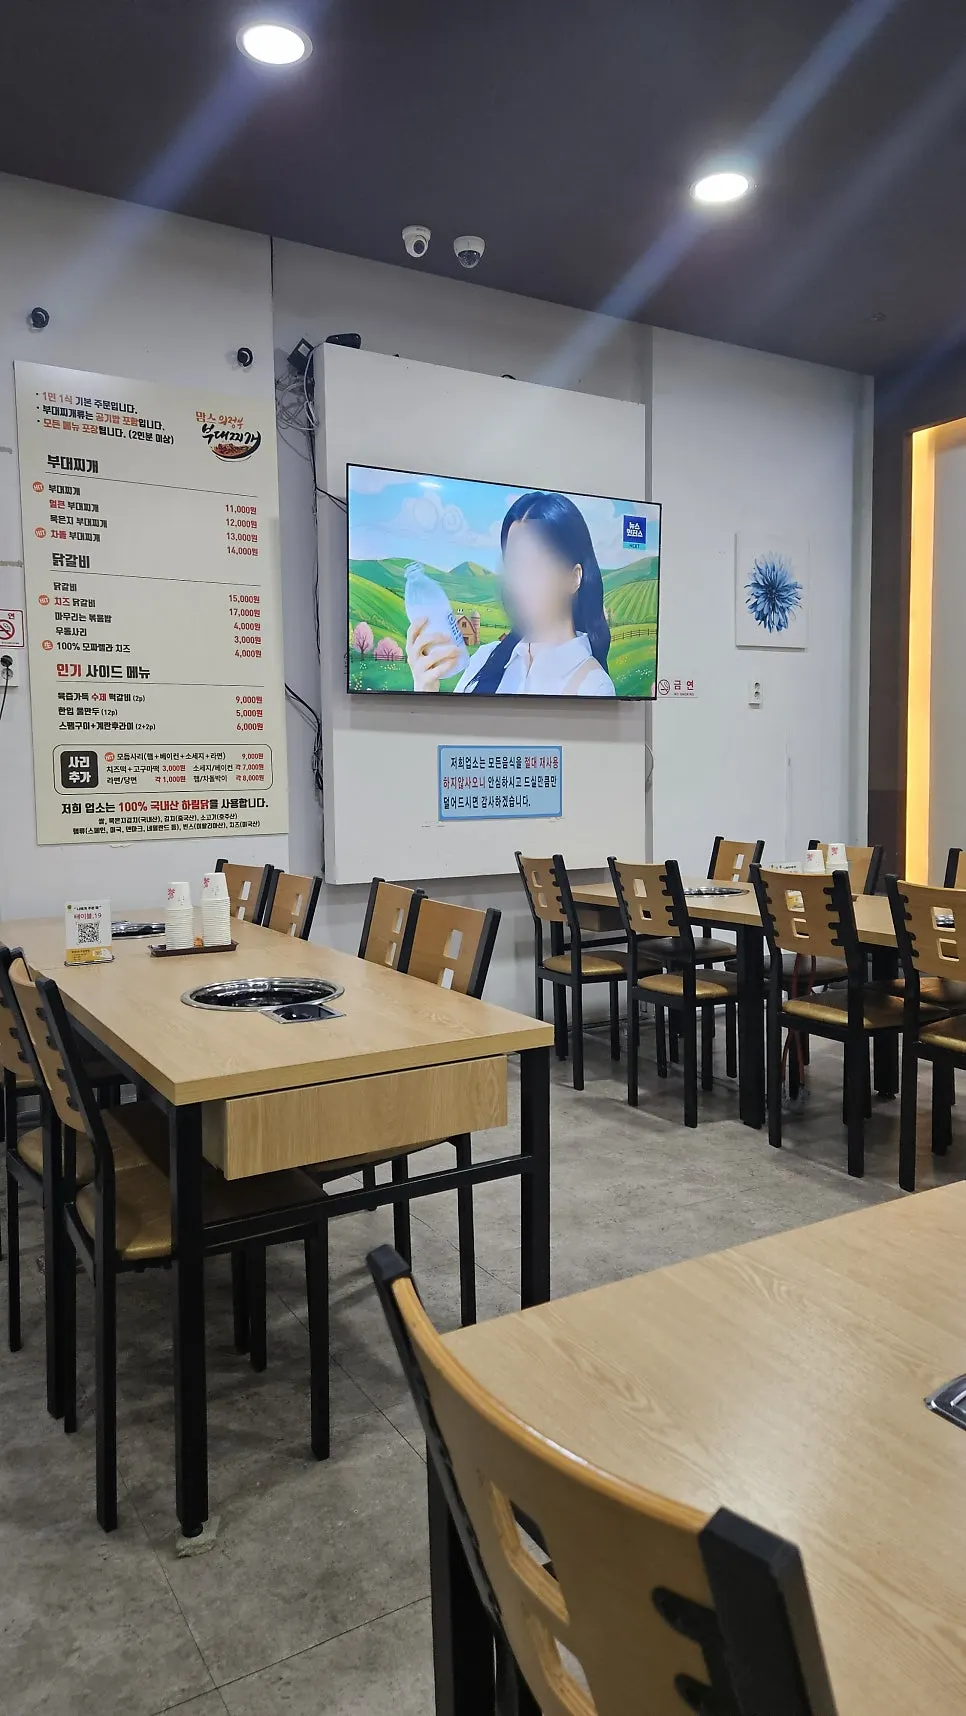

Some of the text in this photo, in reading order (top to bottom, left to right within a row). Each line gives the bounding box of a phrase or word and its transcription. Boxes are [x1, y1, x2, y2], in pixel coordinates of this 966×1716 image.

[43, 392, 138, 414] 1인 1식 기본 주문입니다.
[42, 405, 165, 430] 부대찌개류는 공기밥 포함입니다.
[196, 411, 243, 429] 맘스 의정부
[43, 418, 174, 445] 모든 메뉴 포장됩니다. (2인분 이상)
[202, 423, 261, 445] 부대찌개
[48, 454, 99, 473] 부대찌개
[48, 484, 80, 496] 부대찌개
[225, 505, 257, 515] 11,000원
[68, 501, 99, 512] 부대찌개
[226, 518, 257, 528] 12,000원
[50, 514, 258, 542] 묵은지 부대찌개 13,000원
[629, 522, 640, 530] 뉴스
[51, 530, 66, 539] 차돌
[69, 531, 100, 542] 부대찌개
[227, 546, 258, 556] 14,000원
[52, 553, 90, 568] 닭갈비
[54, 582, 260, 604] 닭갈비 15,000원
[54, 597, 70, 606] 치즈
[72, 598, 96, 608] 닭갈비
[229, 608, 261, 618] 17,000원
[8, 612, 14, 620] 연
[55, 612, 261, 631] 마무리는 볶음밥 4,000원
[56, 627, 261, 644] 우동사리 3,000원
[57, 642, 80, 650] 100%
[115, 644, 130, 653] 치즈
[235, 650, 262, 658] 4,000원
[57, 664, 150, 679] 인기 사이드 메뉴
[674, 680, 693, 690] 금 연
[91, 693, 107, 701] 수제
[236, 696, 263, 704] 9,000원
[58, 707, 74, 715] 한입
[101, 708, 118, 716] (12p)
[236, 710, 263, 718] 5,000원
[136, 723, 156, 731] (2+2p)
[236, 723, 263, 731] 6,000원
[68, 756, 90, 768] 사리
[451, 756, 558, 770] 저희업소는 모든음식을 절대 재사용
[69, 771, 91, 783] 추가
[488, 776, 522, 788] 안심하시고
[524, 776, 557, 788] 드실만큼만
[62, 798, 268, 814] 저희 업소는 100% 국내산 하림닭을 사용합니다.
[444, 795, 530, 810] 덜어드시면 감사하겠습니다.
